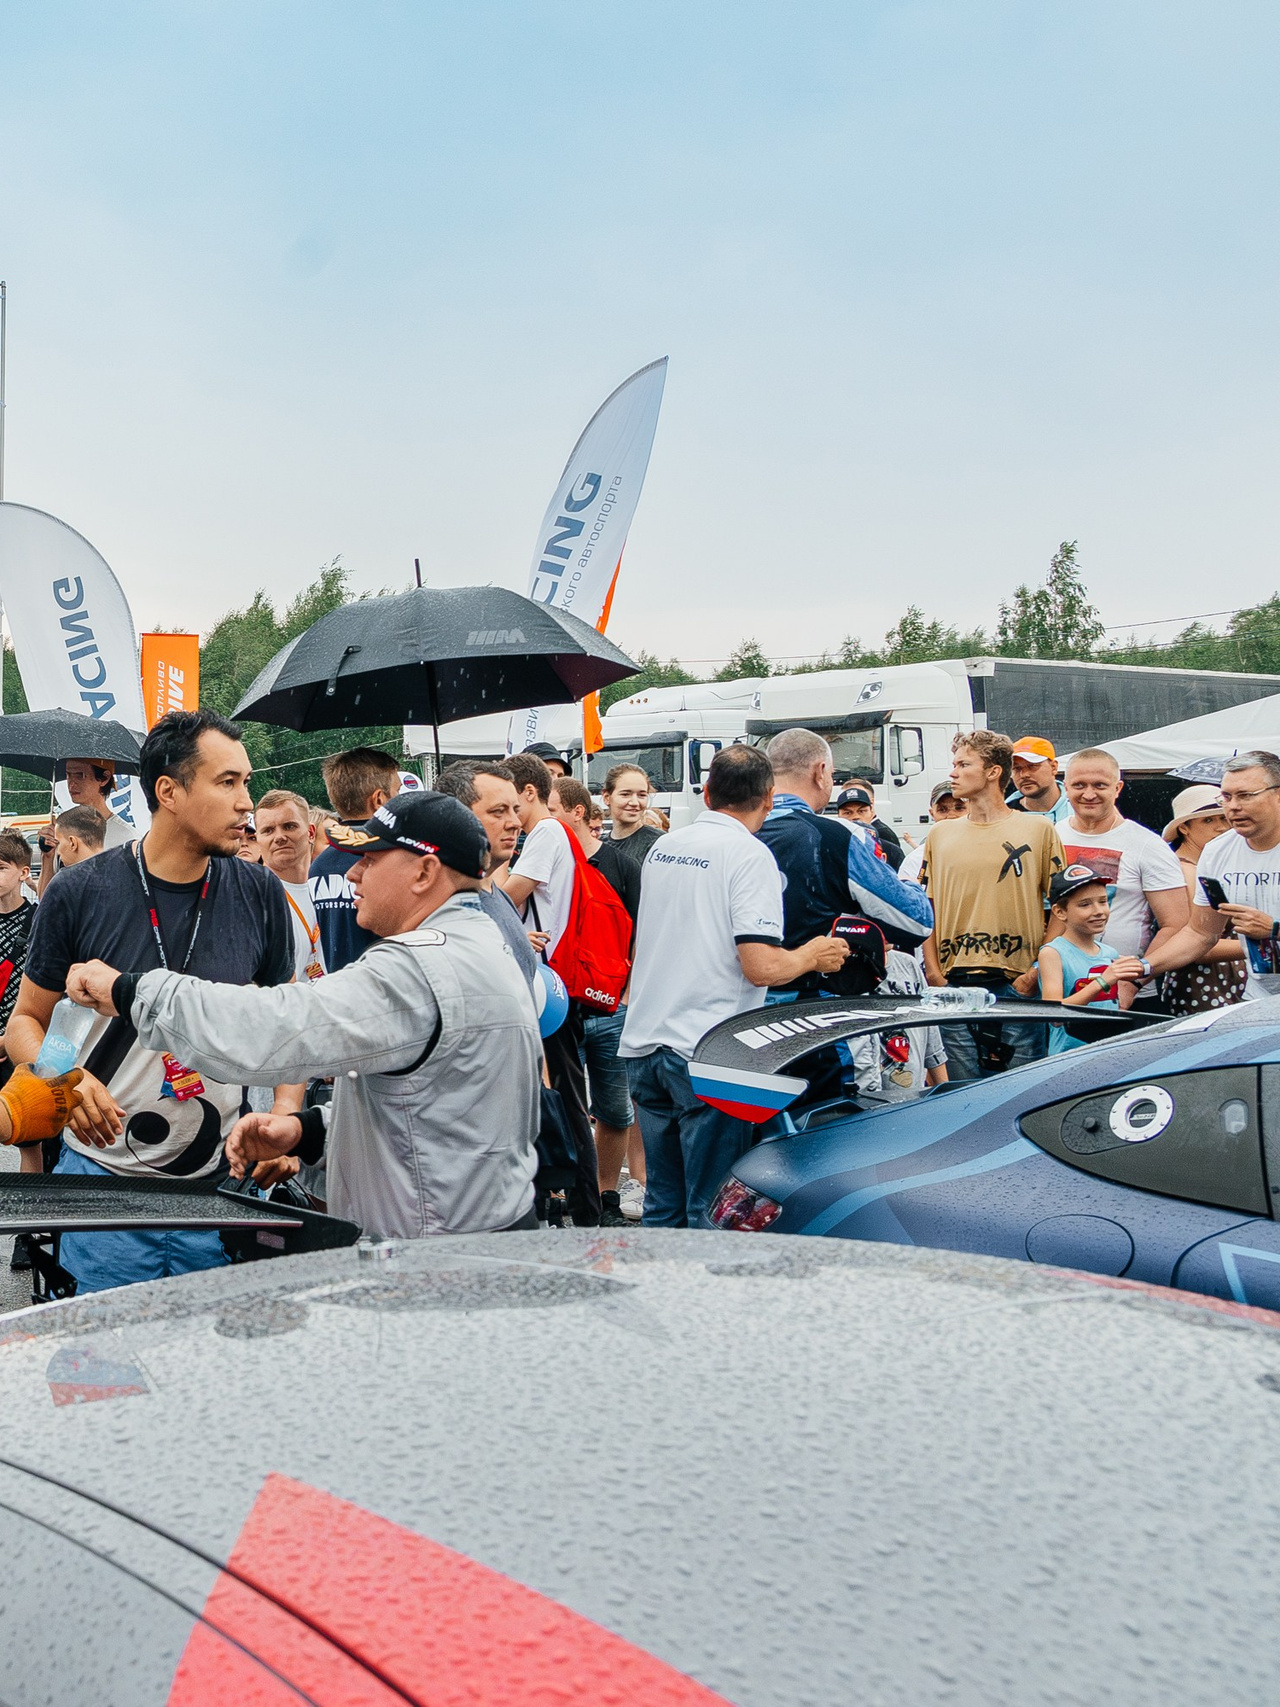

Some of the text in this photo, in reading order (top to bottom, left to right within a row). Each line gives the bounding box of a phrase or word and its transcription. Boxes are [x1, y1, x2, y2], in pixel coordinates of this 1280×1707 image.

[576, 475, 622, 568] автоспорта
[396, 836, 435, 853] ADVAN
[654, 852, 710, 869] SMP RACING
[314, 901, 357, 910] OTORSPOR
[585, 987, 616, 1005] adidas
